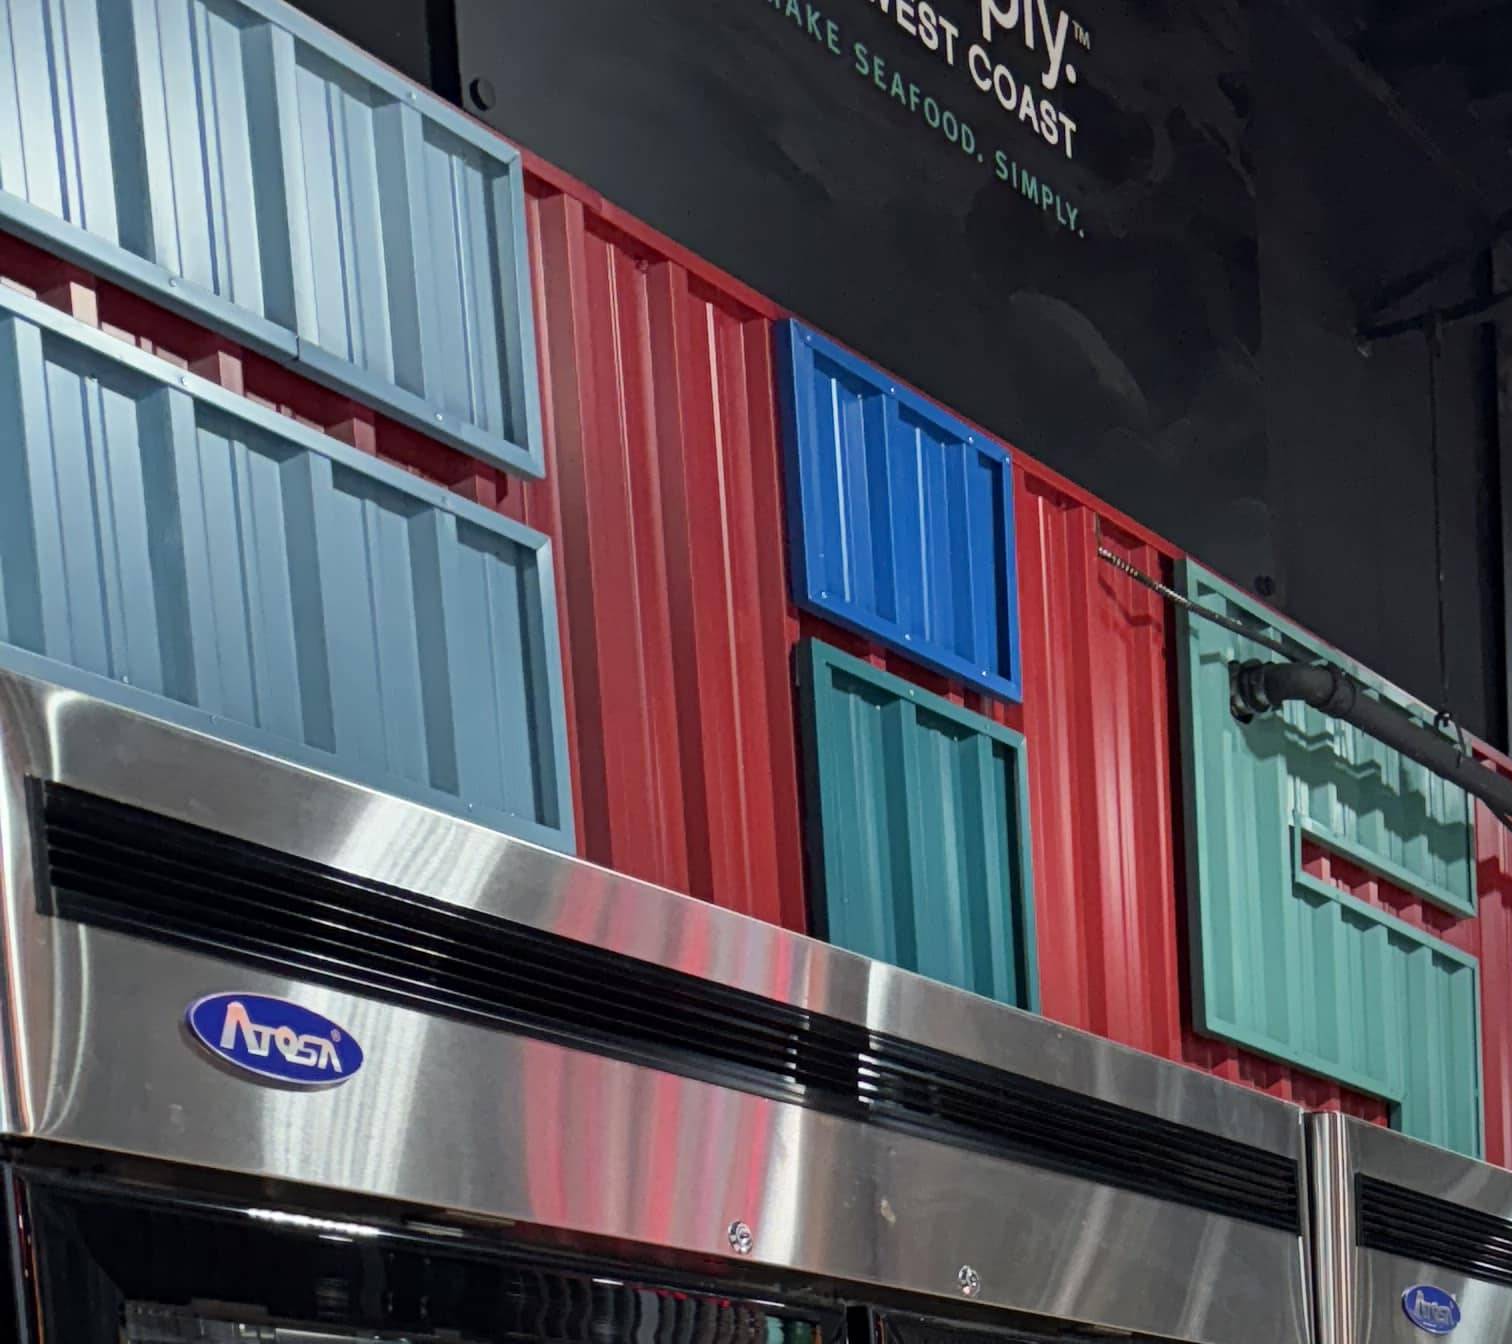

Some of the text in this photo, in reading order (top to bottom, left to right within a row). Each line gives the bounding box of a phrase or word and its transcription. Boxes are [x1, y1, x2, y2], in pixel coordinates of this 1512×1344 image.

[854, 42, 983, 163] SEAFOOD.
[995, 150, 1085, 238] SIMPLY.
[968, 44, 1077, 158] COAST
[220, 1001, 343, 1073] ATOSA
